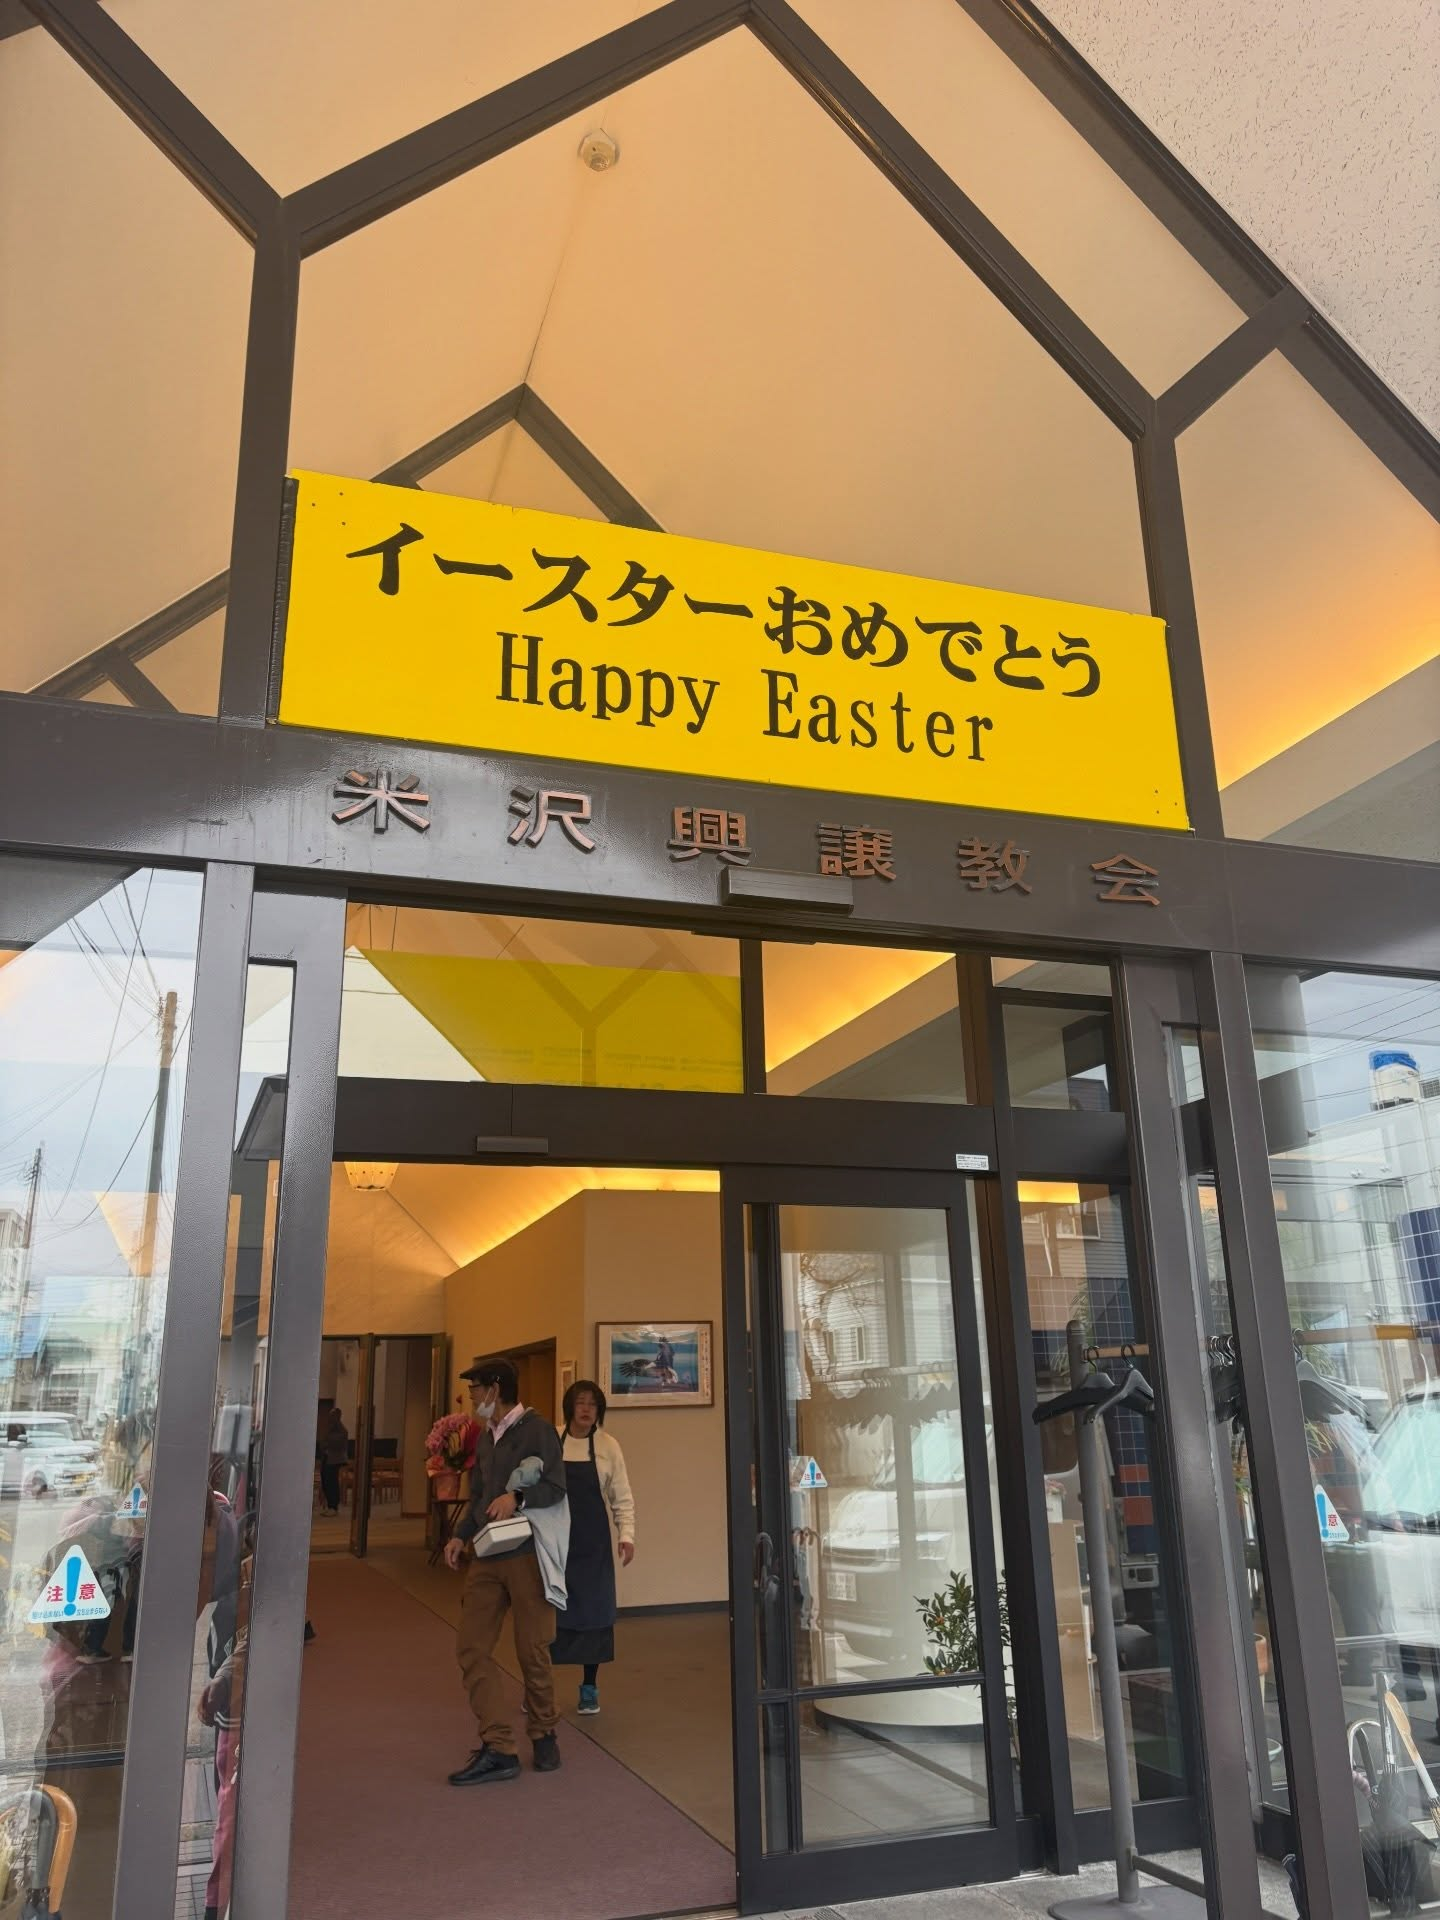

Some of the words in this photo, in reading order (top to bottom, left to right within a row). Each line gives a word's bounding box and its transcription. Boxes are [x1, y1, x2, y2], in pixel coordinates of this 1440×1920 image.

[346, 522, 1102, 698] イースターおめでとう
[496, 631, 720, 734] Happy
[761, 668, 993, 761] Easter
[332, 767, 1161, 907] 米沢興譲教会
